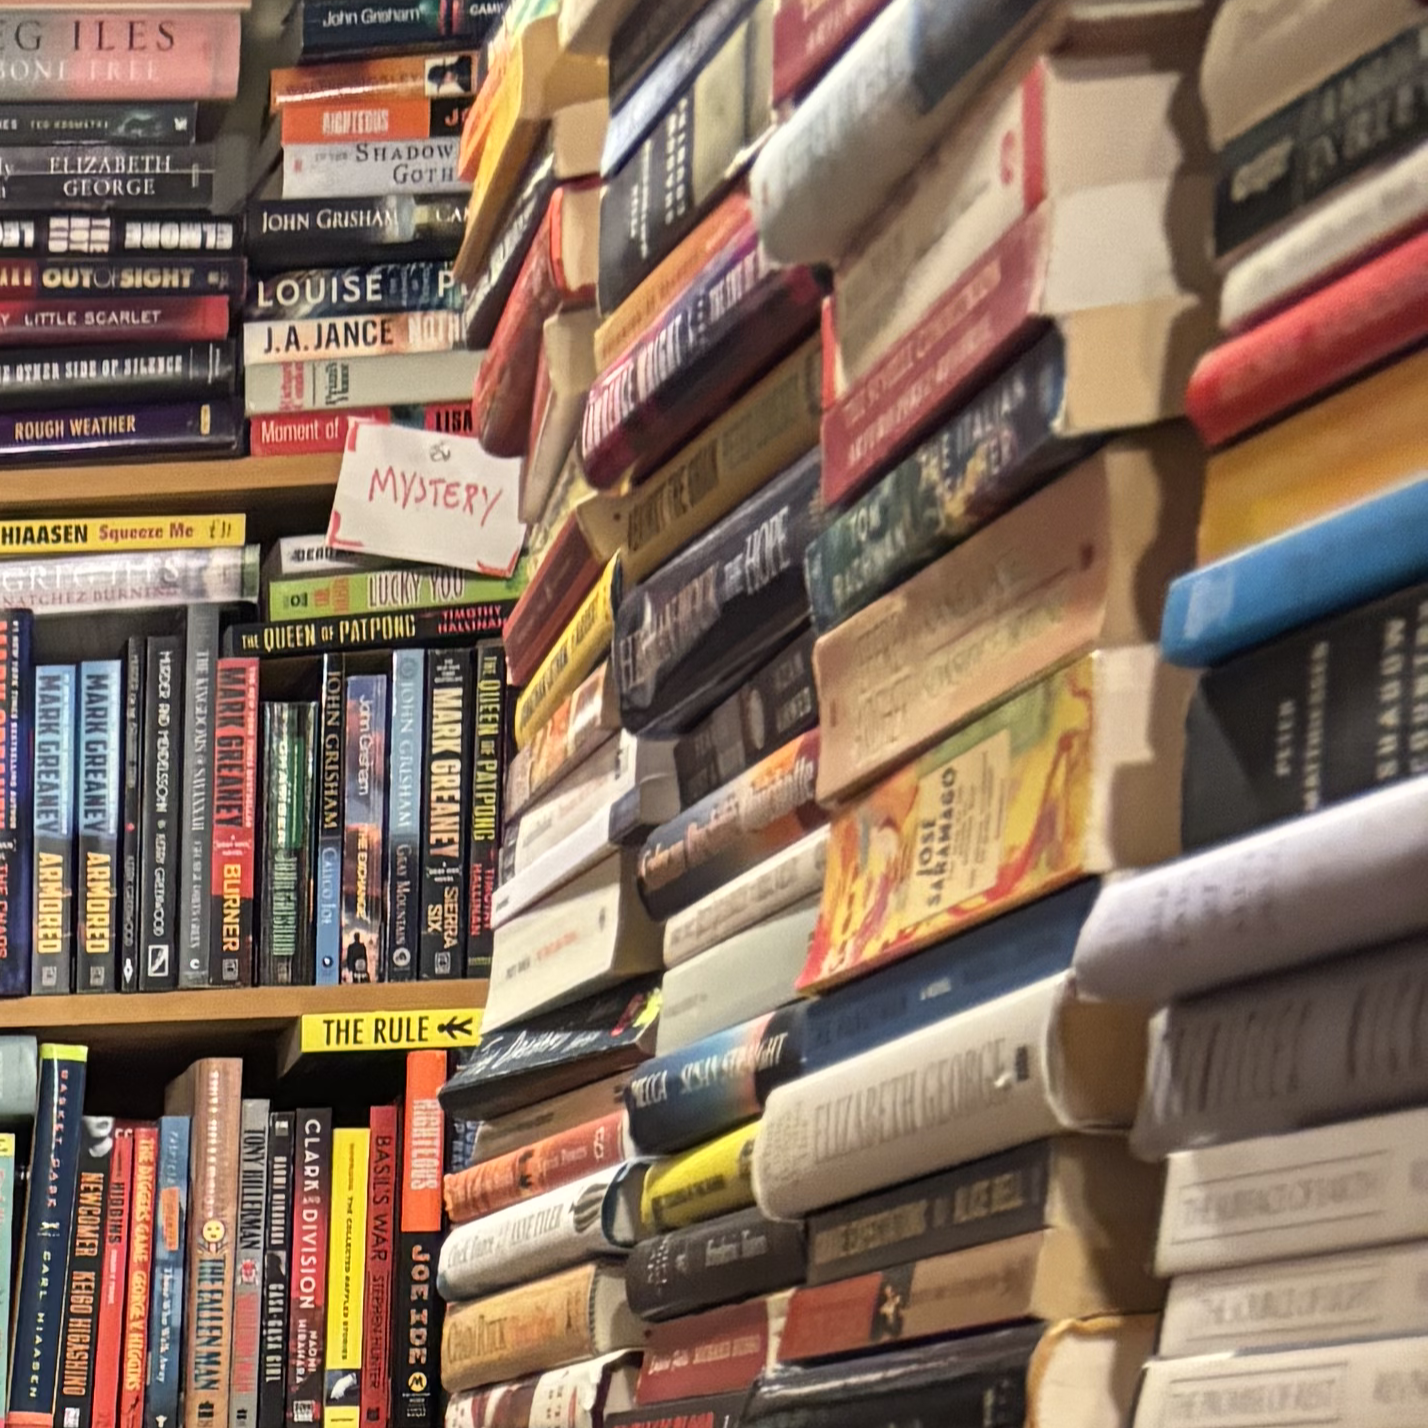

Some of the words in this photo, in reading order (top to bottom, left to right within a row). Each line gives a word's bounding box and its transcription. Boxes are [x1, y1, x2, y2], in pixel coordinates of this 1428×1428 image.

[73, 18, 176, 50] ILES
[63, 179, 156, 197] GEORGE
[262, 210, 310, 232] JOHN
[256, 276, 382, 308] LOUISE
[24, 311, 78, 326] LITTLE
[84, 310, 162, 325] SCARLET
[314, 321, 394, 349] JANCE
[15, 418, 64, 440] ROUGH
[70, 415, 136, 438] WEATHER
[261, 422, 319, 445] Moment
[368, 466, 503, 525] MYSTERY
[0, 524, 88, 544] HIAASEN
[264, 625, 315, 649] QUEEN
[323, 1019, 364, 1046] THE
[374, 1016, 429, 1043] RULE
[411, 1246, 431, 1297] JOE
[409, 1304, 428, 1364] IDE
